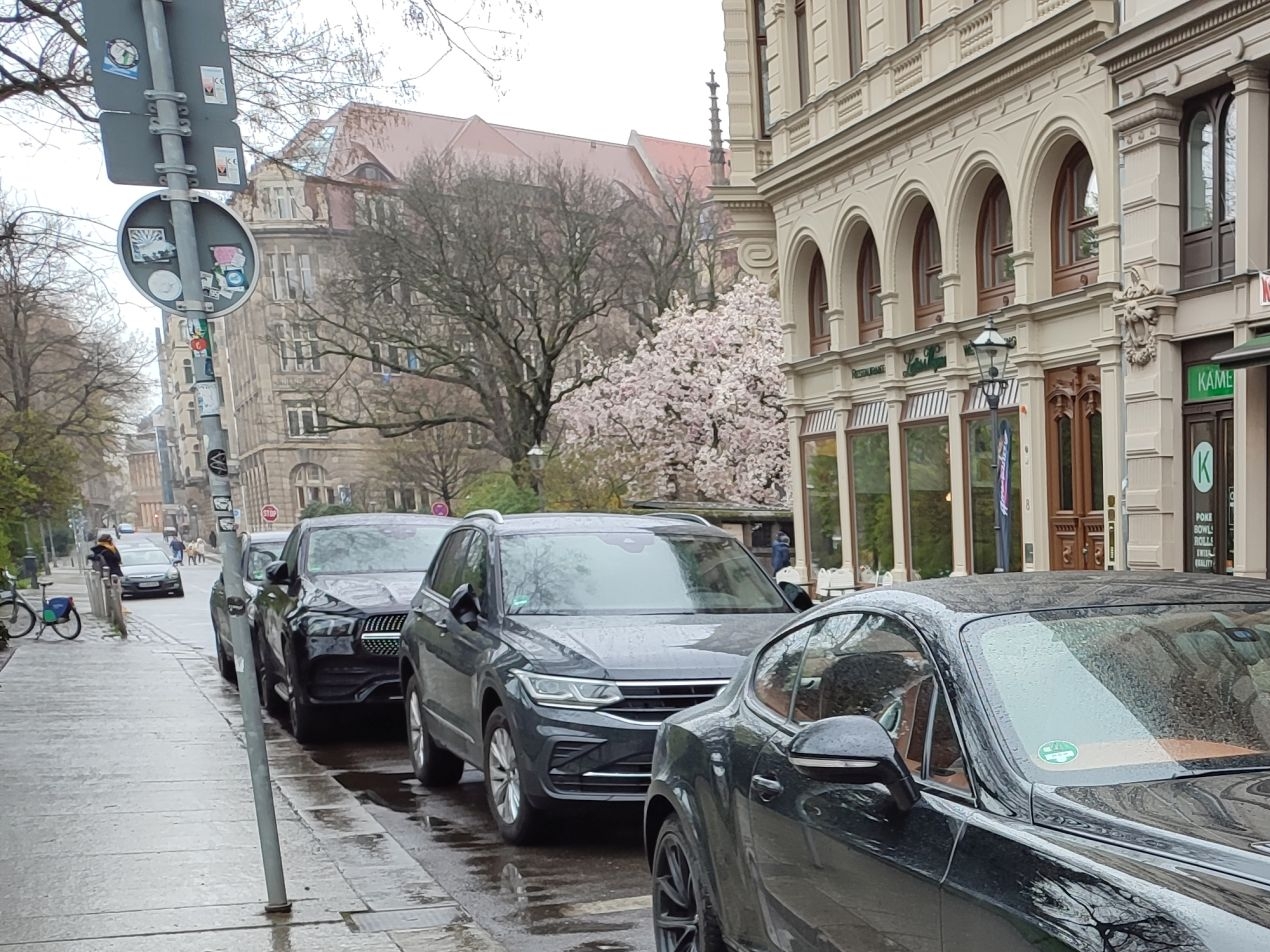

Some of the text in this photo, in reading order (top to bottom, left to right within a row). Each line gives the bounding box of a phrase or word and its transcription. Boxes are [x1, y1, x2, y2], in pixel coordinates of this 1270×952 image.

[1198, 369, 1233, 392] KAME
[1199, 451, 1210, 483] K
[262, 509, 277, 518] STOP
